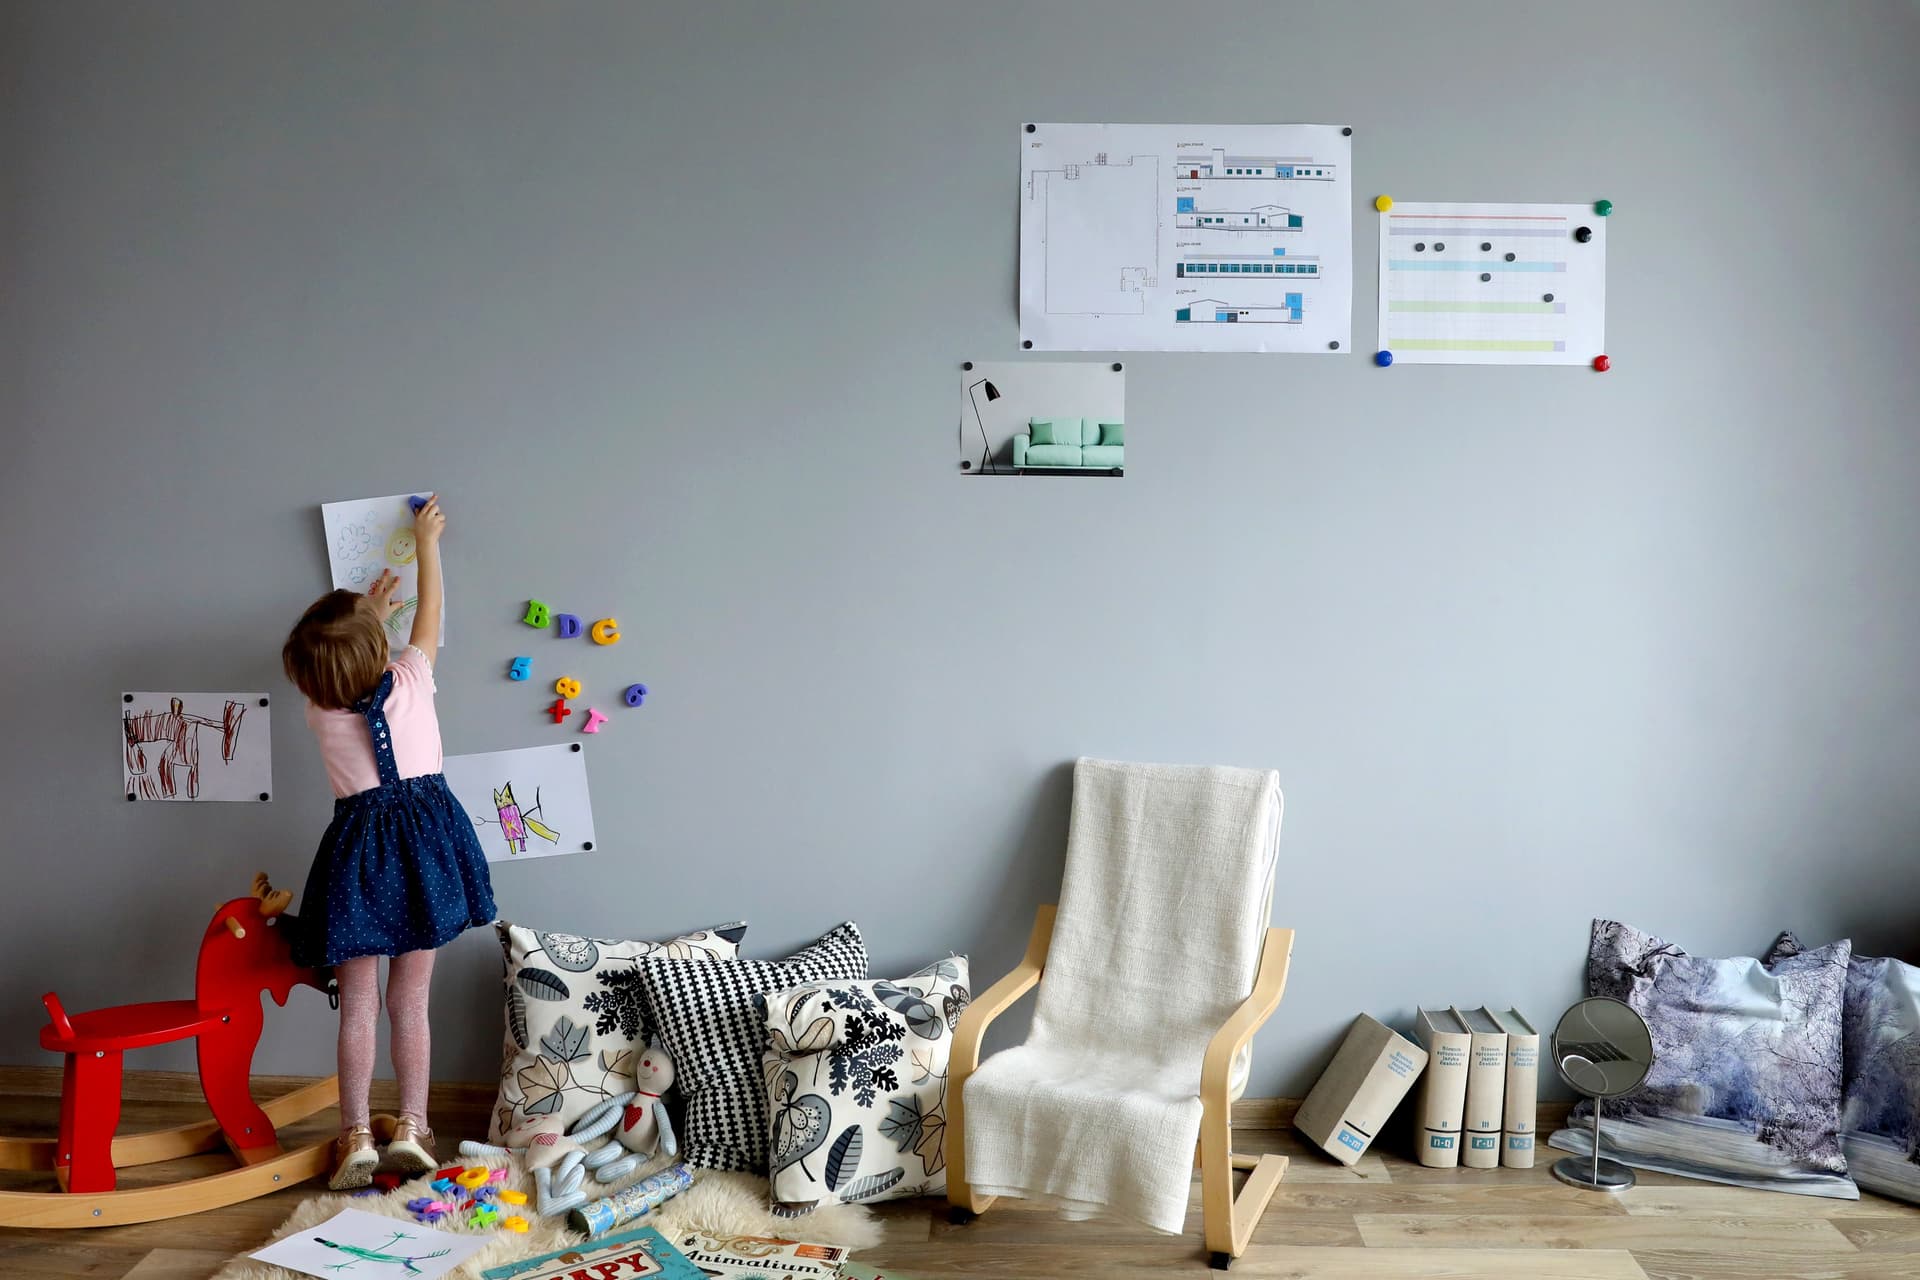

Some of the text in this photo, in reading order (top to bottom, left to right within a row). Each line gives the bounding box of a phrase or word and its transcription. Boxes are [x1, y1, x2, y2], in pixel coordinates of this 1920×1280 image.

[523, 599, 621, 646] B D C
[509, 656, 533, 681] 5
[625, 683, 648, 708] 6
[1433, 1138, 1451, 1148] n-q
[1476, 1139, 1493, 1148] r-u
[549, 1252, 649, 1280] APY
[684, 1250, 821, 1274] Animalium
